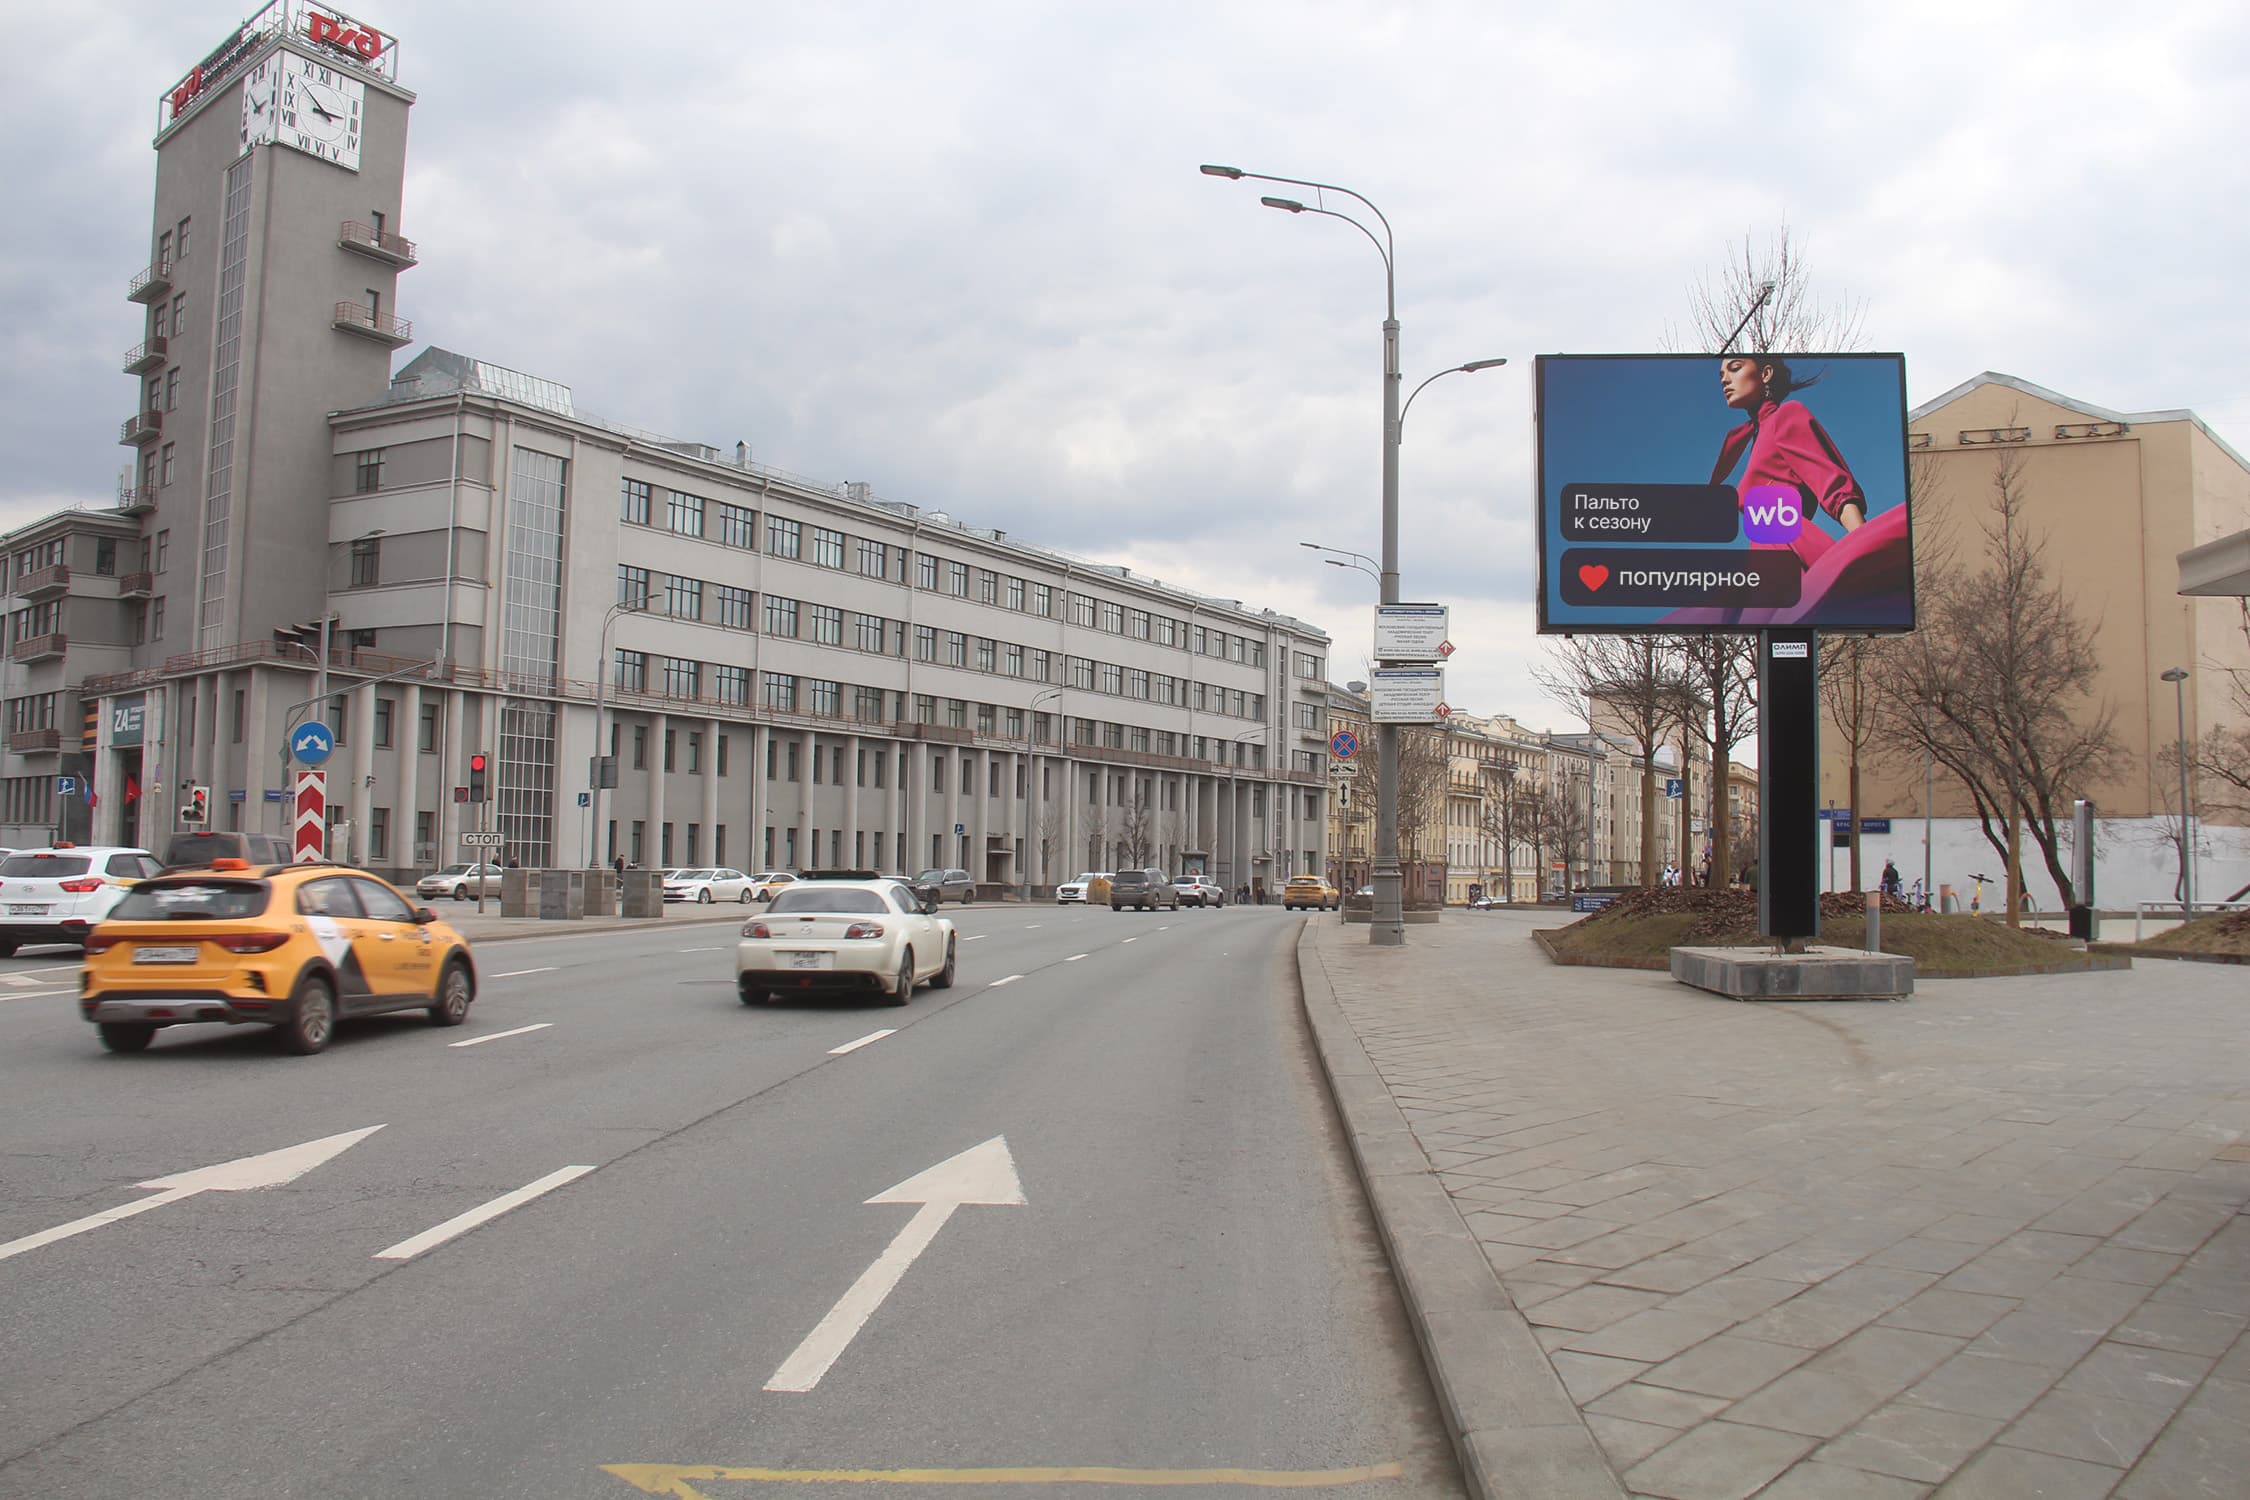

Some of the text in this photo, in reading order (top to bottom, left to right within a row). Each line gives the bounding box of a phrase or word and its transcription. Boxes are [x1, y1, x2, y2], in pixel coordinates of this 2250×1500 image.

[1574, 494, 1640, 510] Пальто
[1747, 497, 1799, 527] wb
[1574, 516, 1652, 534] к сезону
[1619, 570, 1761, 592] популярное
[466, 834, 501, 844] СТОП
